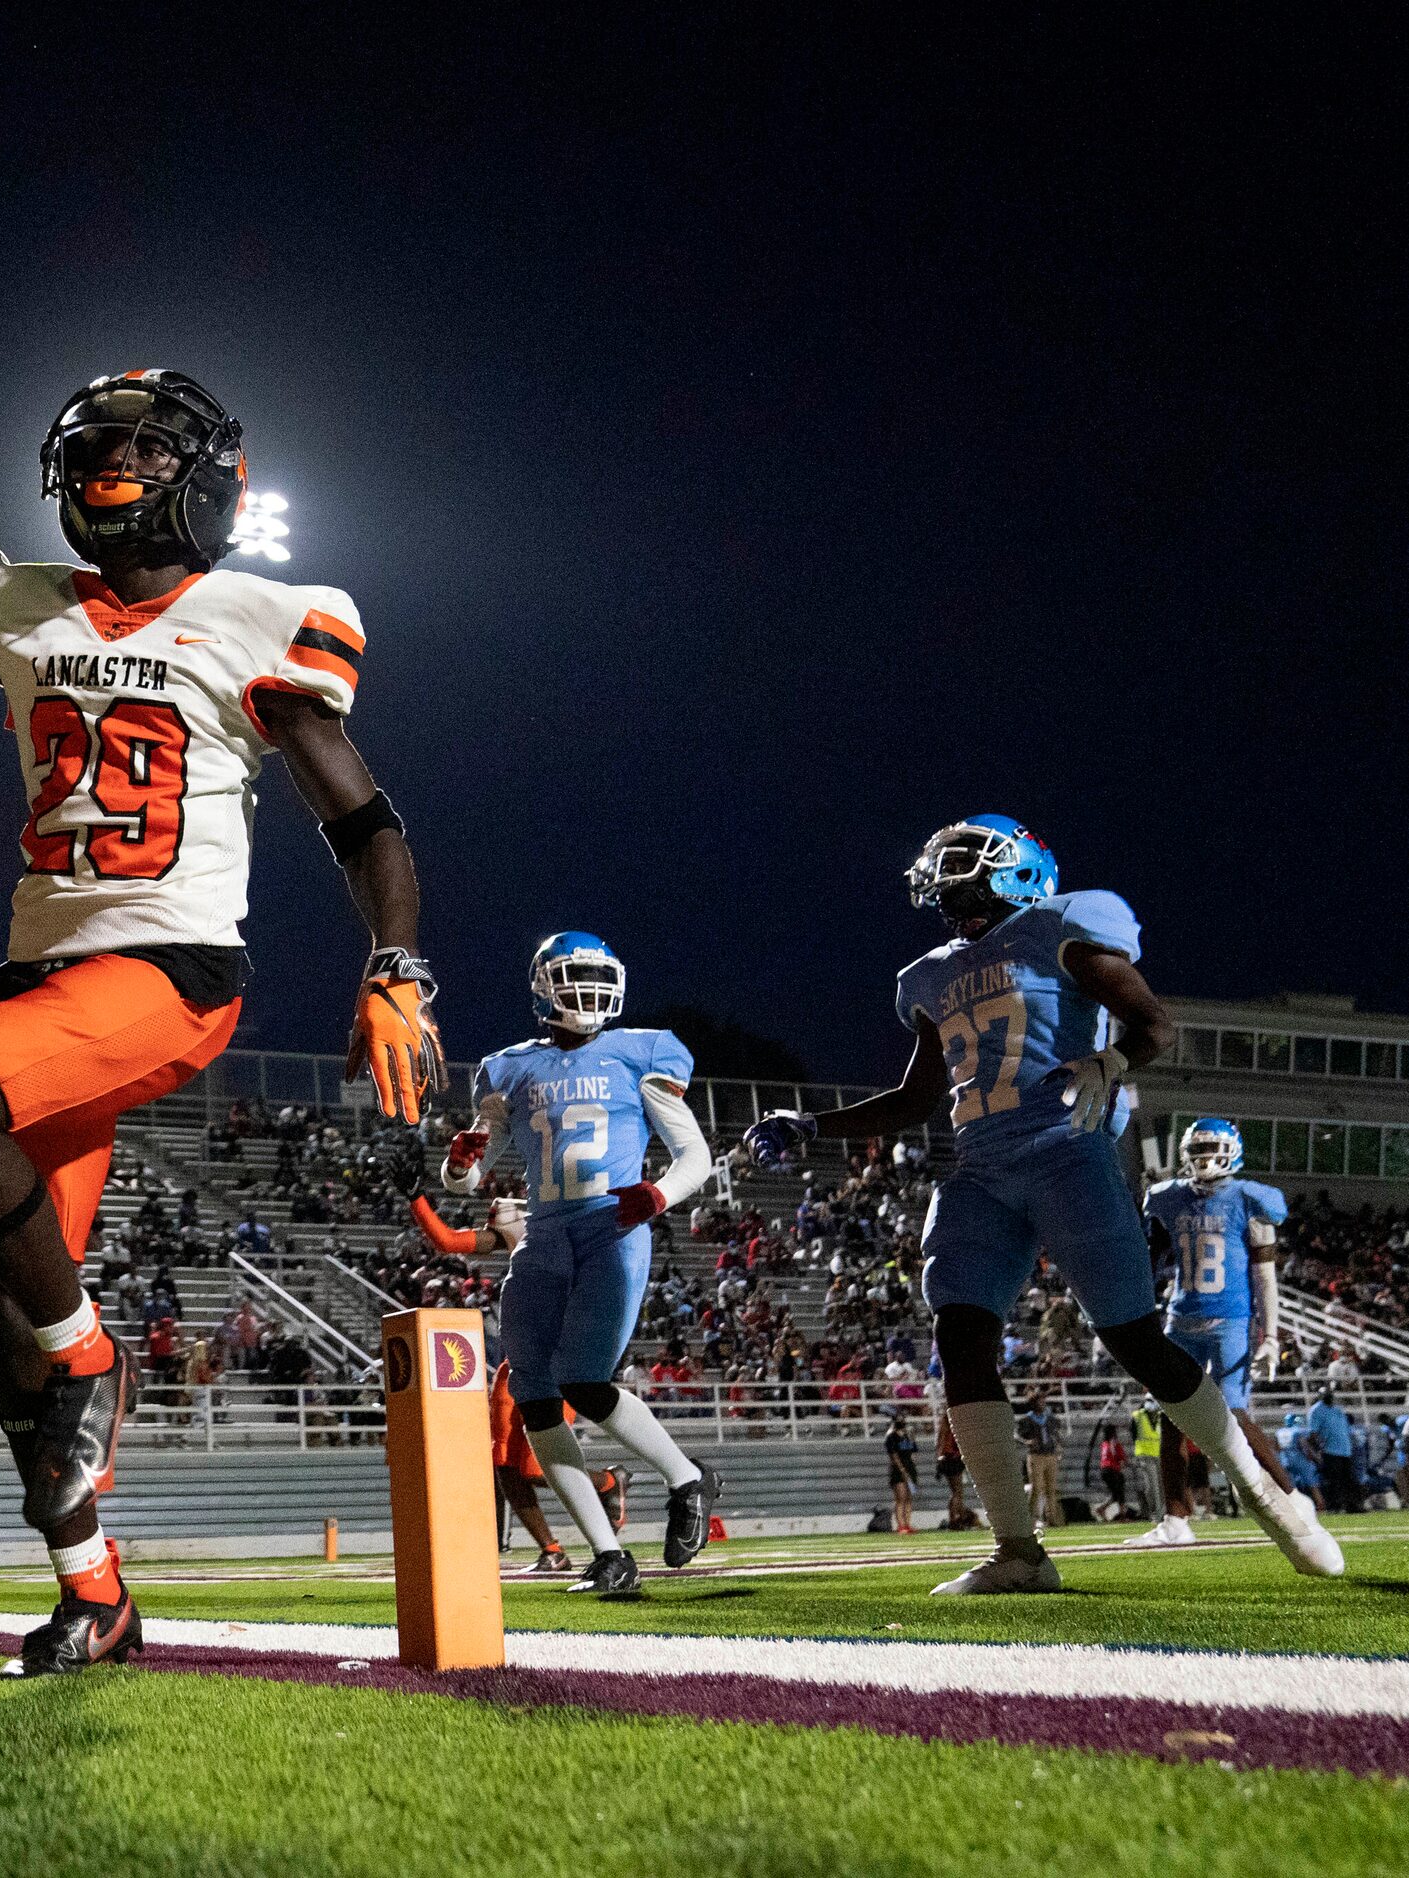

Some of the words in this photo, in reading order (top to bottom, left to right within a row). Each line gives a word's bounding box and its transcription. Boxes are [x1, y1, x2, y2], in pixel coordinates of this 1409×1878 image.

[32, 655, 168, 690] LANCASTER
[20, 695, 192, 881] 29
[942, 960, 1017, 1016] SKYLINE
[938, 990, 1028, 1128] 27
[528, 1076, 611, 1108] SKYLINE
[529, 1103, 609, 1201] 12
[1178, 1232, 1226, 1294] 18
